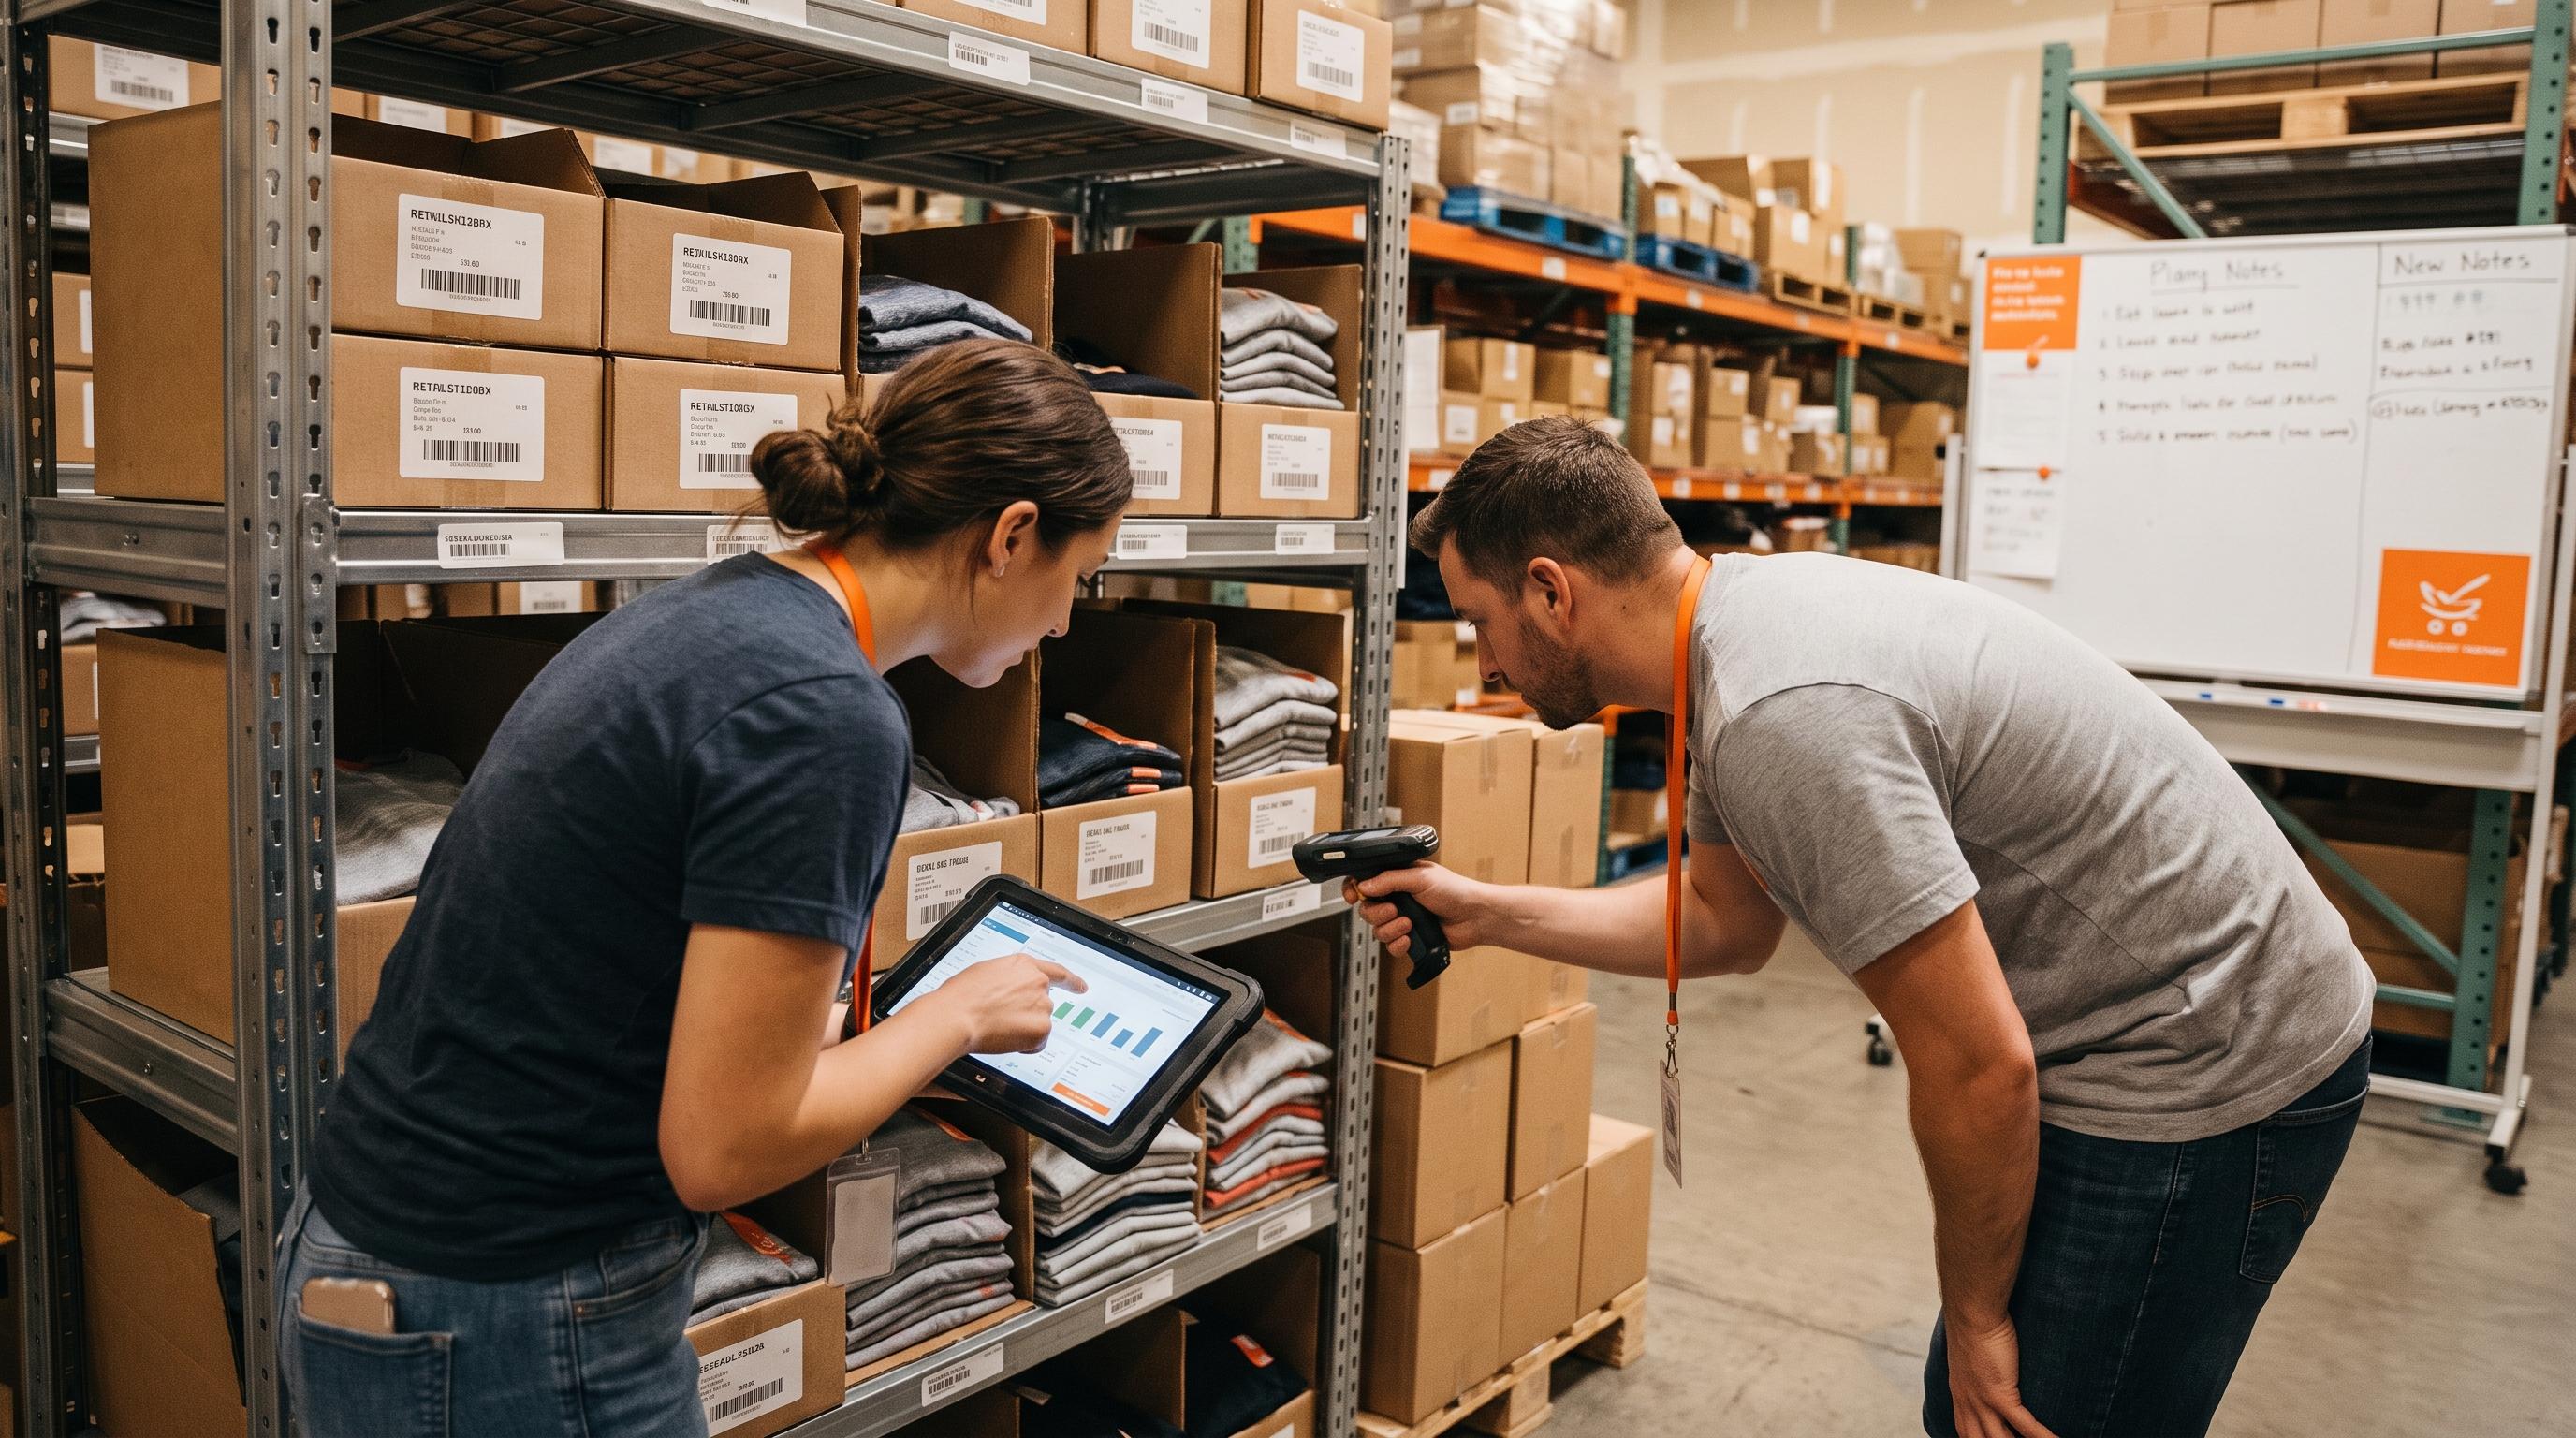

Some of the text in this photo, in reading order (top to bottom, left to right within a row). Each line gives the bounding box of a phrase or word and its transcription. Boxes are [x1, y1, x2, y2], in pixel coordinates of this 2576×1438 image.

[2224, 260, 2285, 281] Notes
[2394, 251, 2532, 275] New Notes
